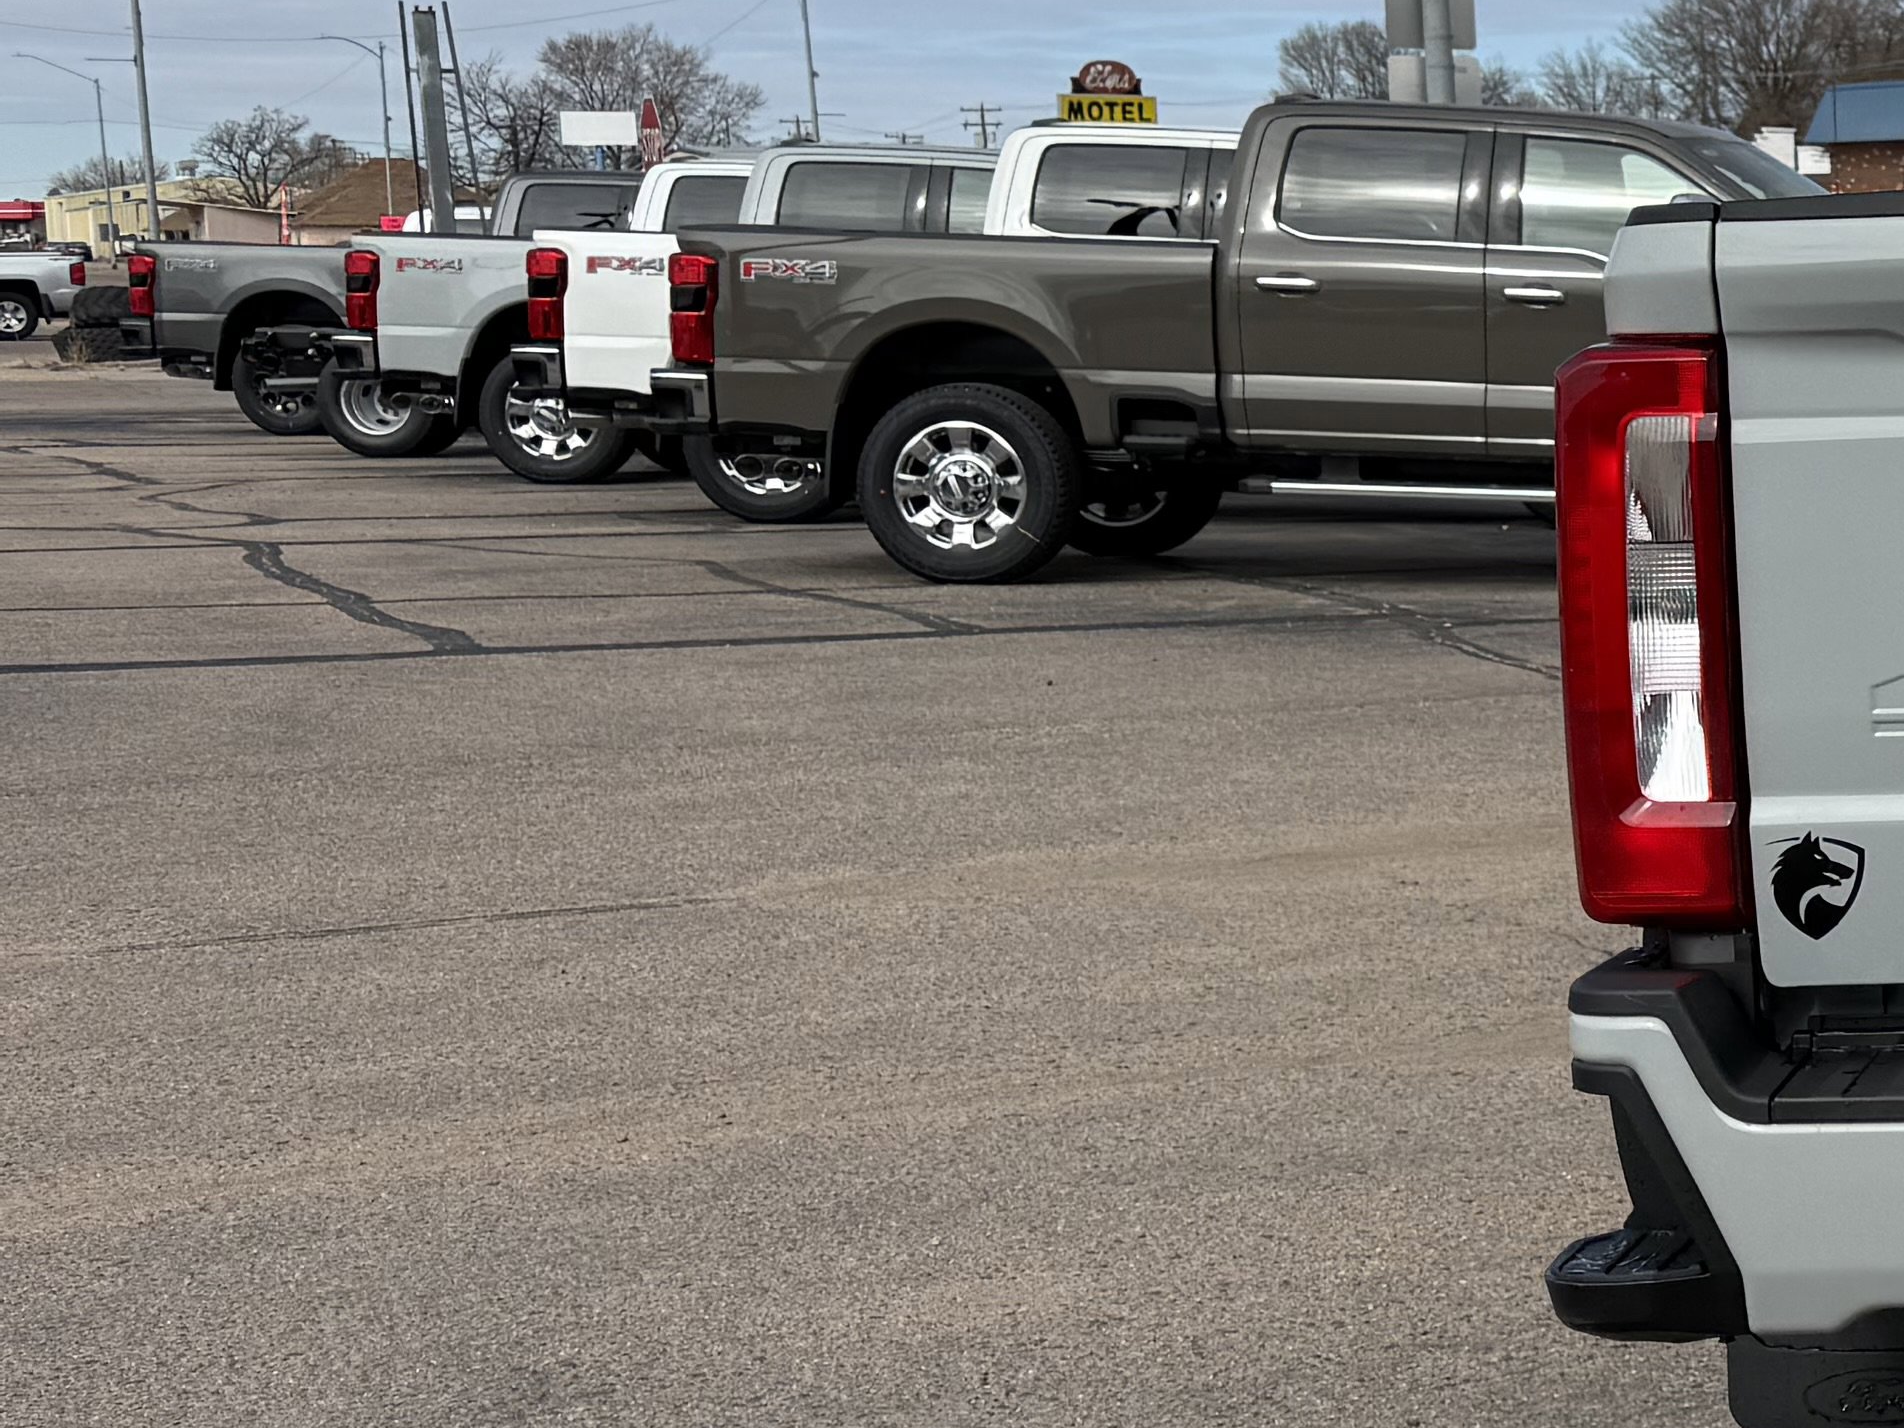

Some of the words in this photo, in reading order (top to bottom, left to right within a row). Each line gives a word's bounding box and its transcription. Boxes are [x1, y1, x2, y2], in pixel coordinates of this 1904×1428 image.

[1067, 99, 1152, 123] MOTEL
[395, 257, 463, 273] FX4
[586, 256, 665, 274] FX4
[740, 258, 837, 283] FX4
